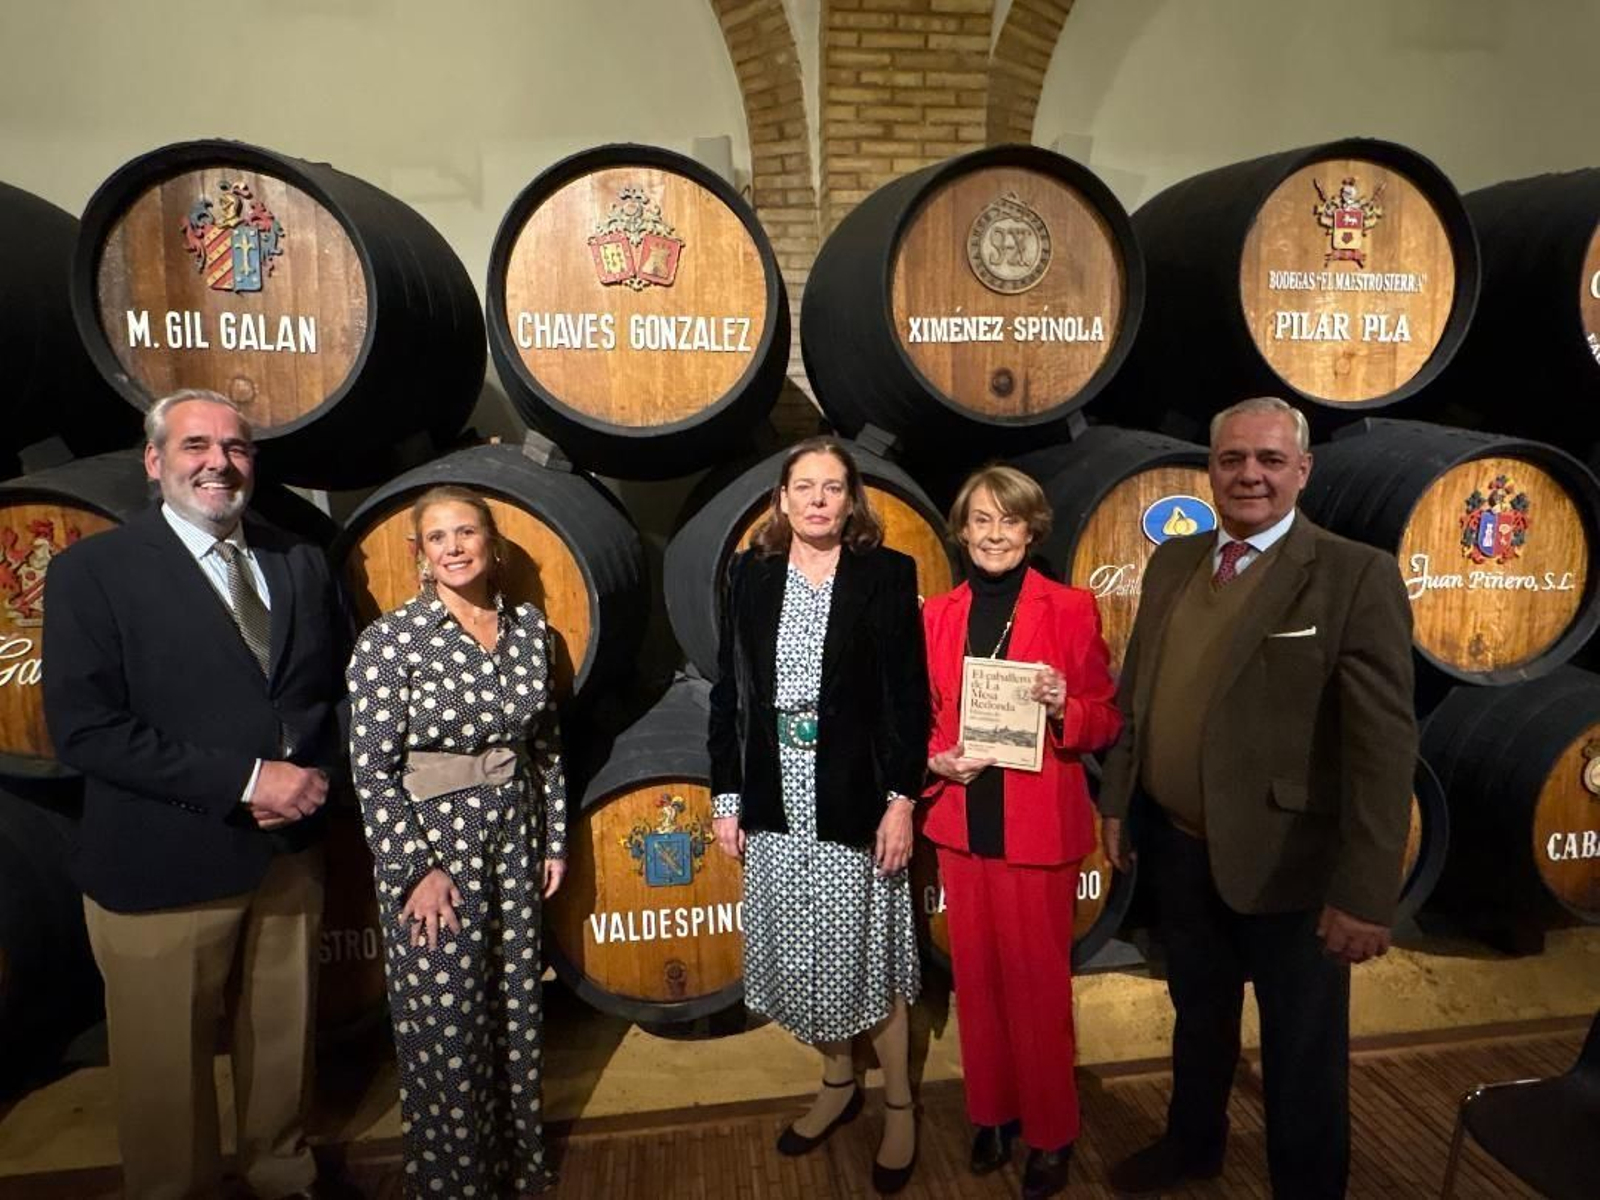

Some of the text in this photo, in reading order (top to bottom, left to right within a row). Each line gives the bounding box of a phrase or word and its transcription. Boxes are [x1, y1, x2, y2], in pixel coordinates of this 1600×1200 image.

[1268, 270, 1315, 290] BODEGAS
[1335, 272, 1382, 292] MAESTRO
[126, 310, 318, 354] M. GIL GALAN
[517, 311, 751, 352] CHAVES GONZALEZ
[1275, 311, 1412, 342] PILAR PLA
[1405, 554, 1464, 599] Juan
[1469, 570, 1538, 592] Piñero,
[1547, 830, 1600, 861] CAB
